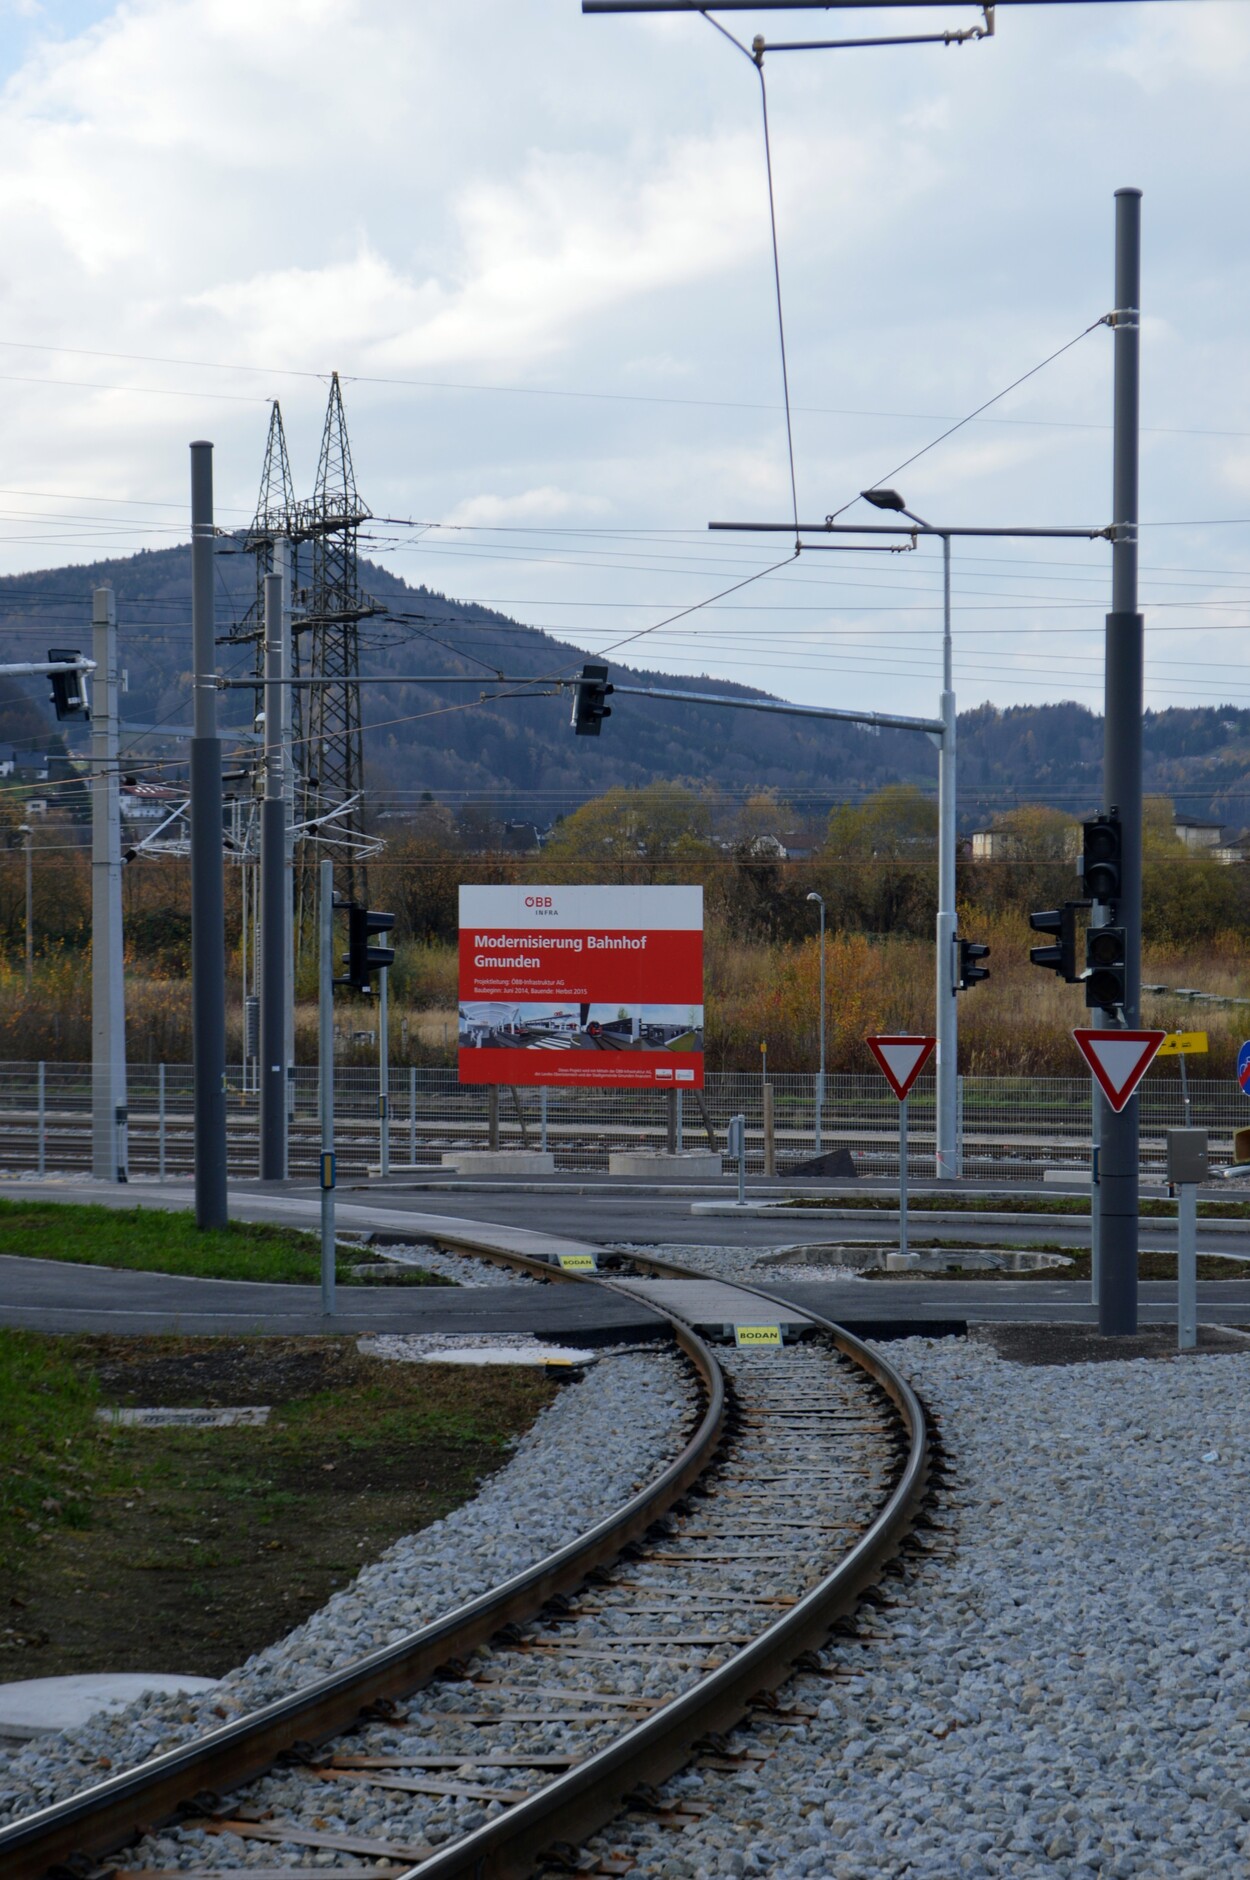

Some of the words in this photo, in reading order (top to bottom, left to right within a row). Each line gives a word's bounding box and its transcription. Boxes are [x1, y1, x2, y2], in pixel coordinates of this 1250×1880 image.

[525, 897, 552, 907] ÖBB
[474, 935, 582, 952] Modernisierung
[587, 936, 647, 949] Bahnhof
[474, 955, 540, 968] Gmunden
